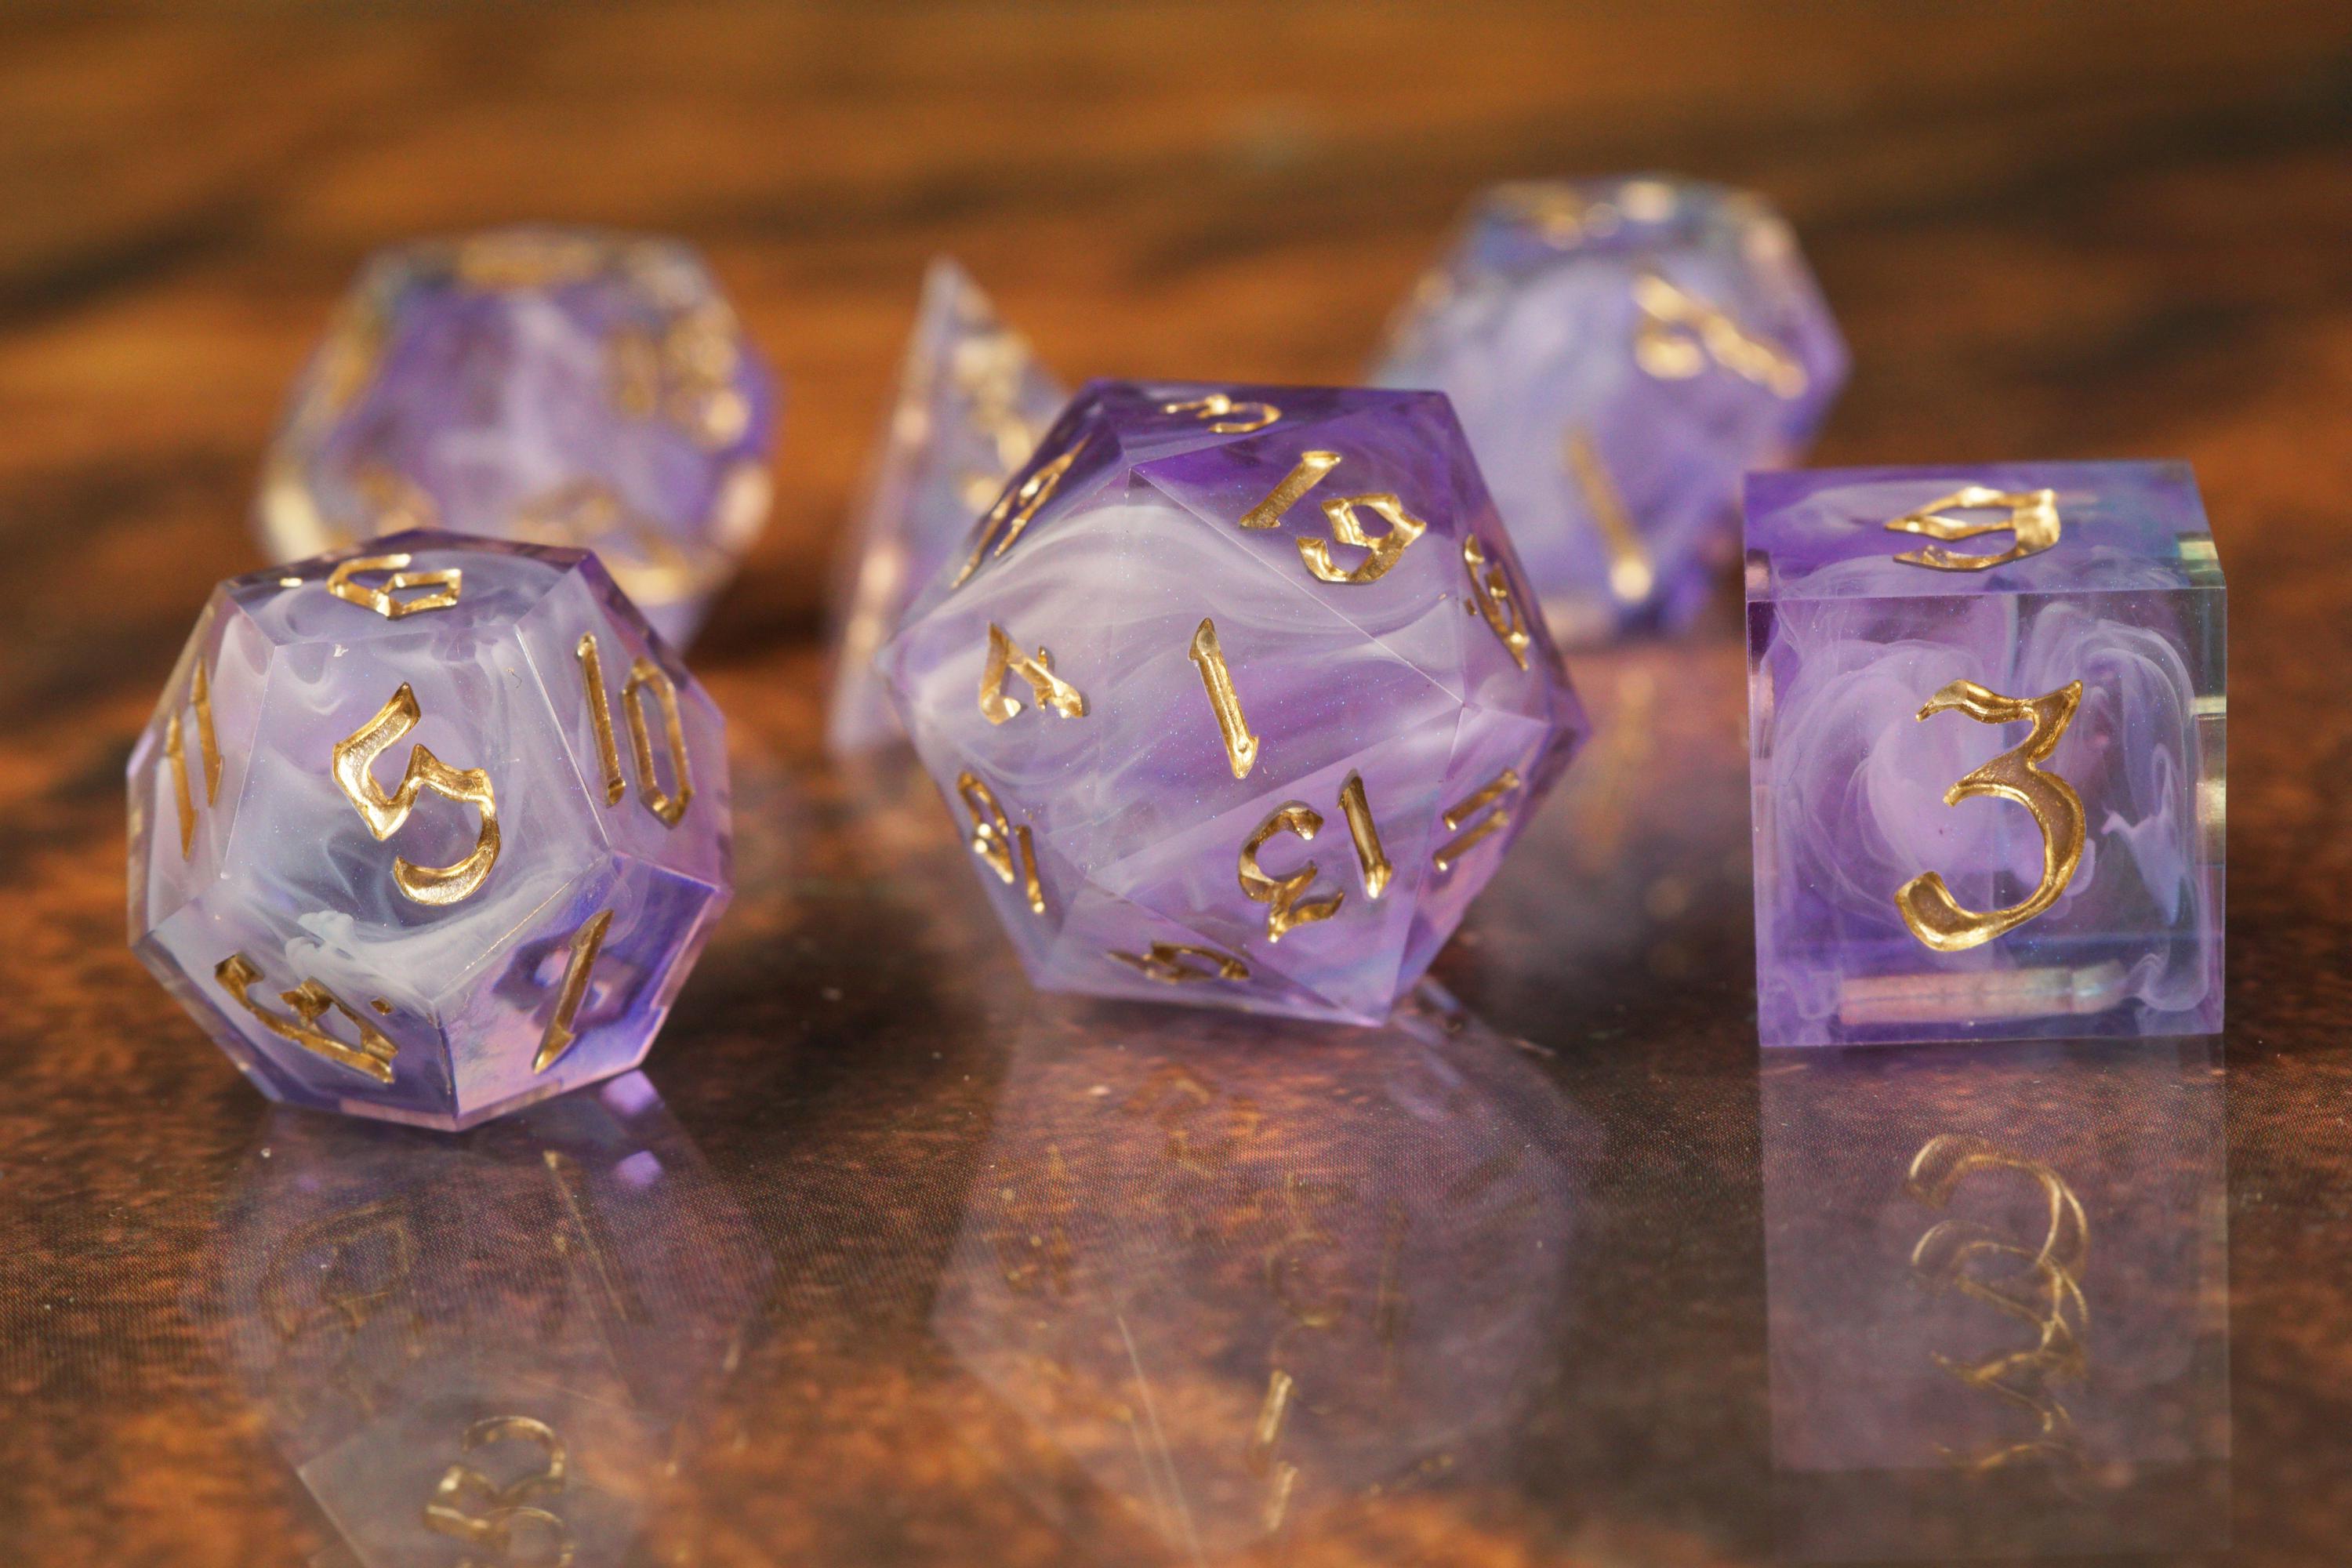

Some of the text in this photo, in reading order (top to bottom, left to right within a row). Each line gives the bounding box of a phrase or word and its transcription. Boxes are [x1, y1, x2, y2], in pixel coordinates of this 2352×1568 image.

[1238, 450, 1427, 586] 19
[576, 631, 695, 829] 10
[1188, 617, 1259, 779] 1
[332, 682, 500, 905] 5
[1238, 768, 1392, 944] 13
[1894, 678, 2086, 952] 3
[532, 909, 615, 1074] 1
